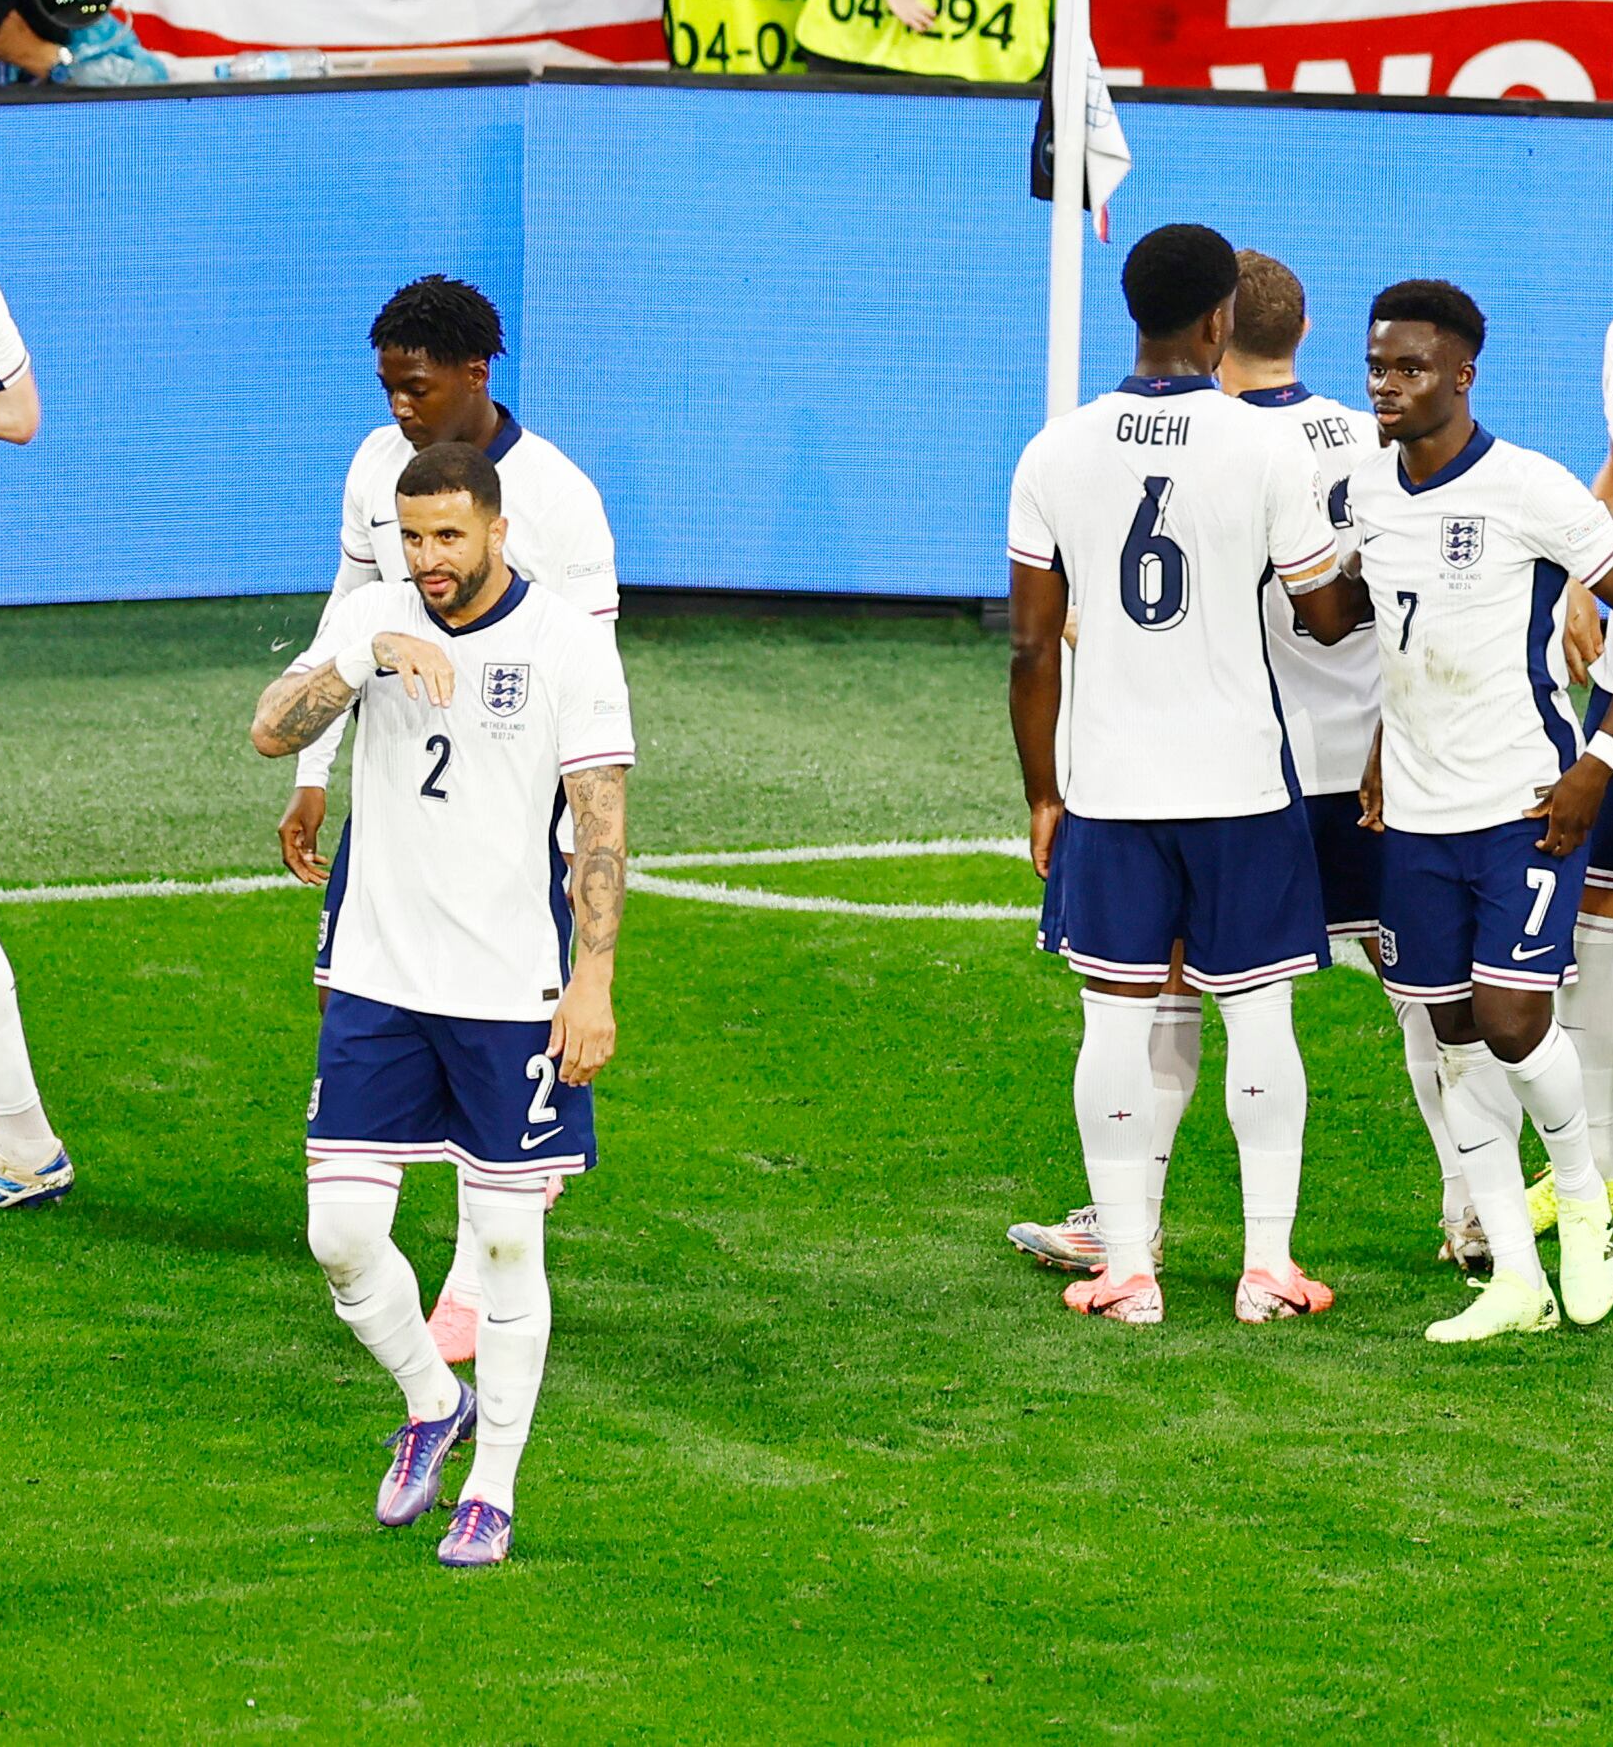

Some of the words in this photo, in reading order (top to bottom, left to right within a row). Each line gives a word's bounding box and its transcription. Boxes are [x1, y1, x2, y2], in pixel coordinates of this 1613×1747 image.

[1115, 408, 1191, 446] GUÉHI
[1119, 474, 1190, 632] 6
[1396, 590, 1421, 655] 7
[420, 733, 452, 803] 2
[1524, 868, 1558, 938] 7
[524, 1053, 558, 1125] 2
